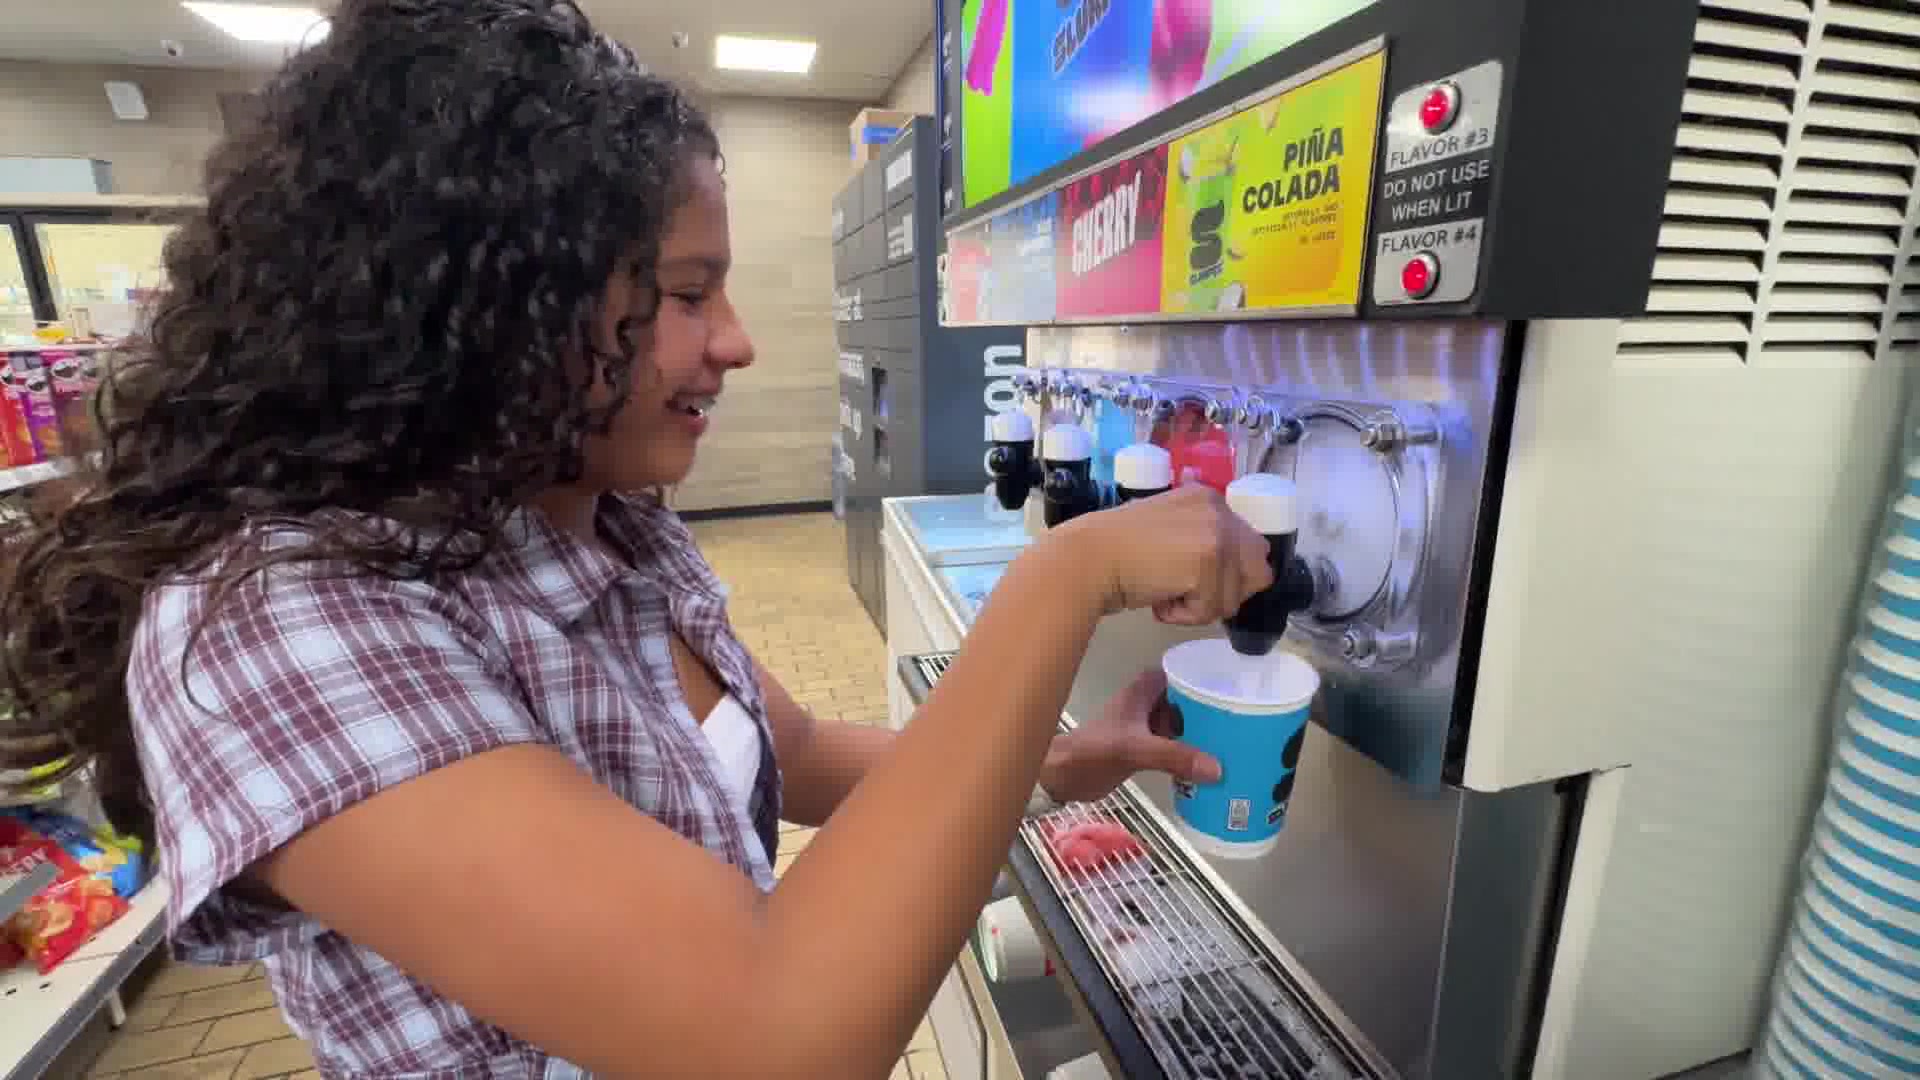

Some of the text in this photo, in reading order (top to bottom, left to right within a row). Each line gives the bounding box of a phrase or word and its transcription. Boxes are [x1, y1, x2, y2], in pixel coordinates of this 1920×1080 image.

[1284, 126, 1344, 171] PIÑA
[1390, 127, 1489, 169] FLAVOR #3
[1243, 164, 1340, 214] COLADA
[1384, 160, 1490, 199] DO NOT USE
[1071, 169, 1142, 277] CHERRY
[1391, 191, 1473, 222] WHEN LIT
[1382, 225, 1477, 253] FLAVOR #4
